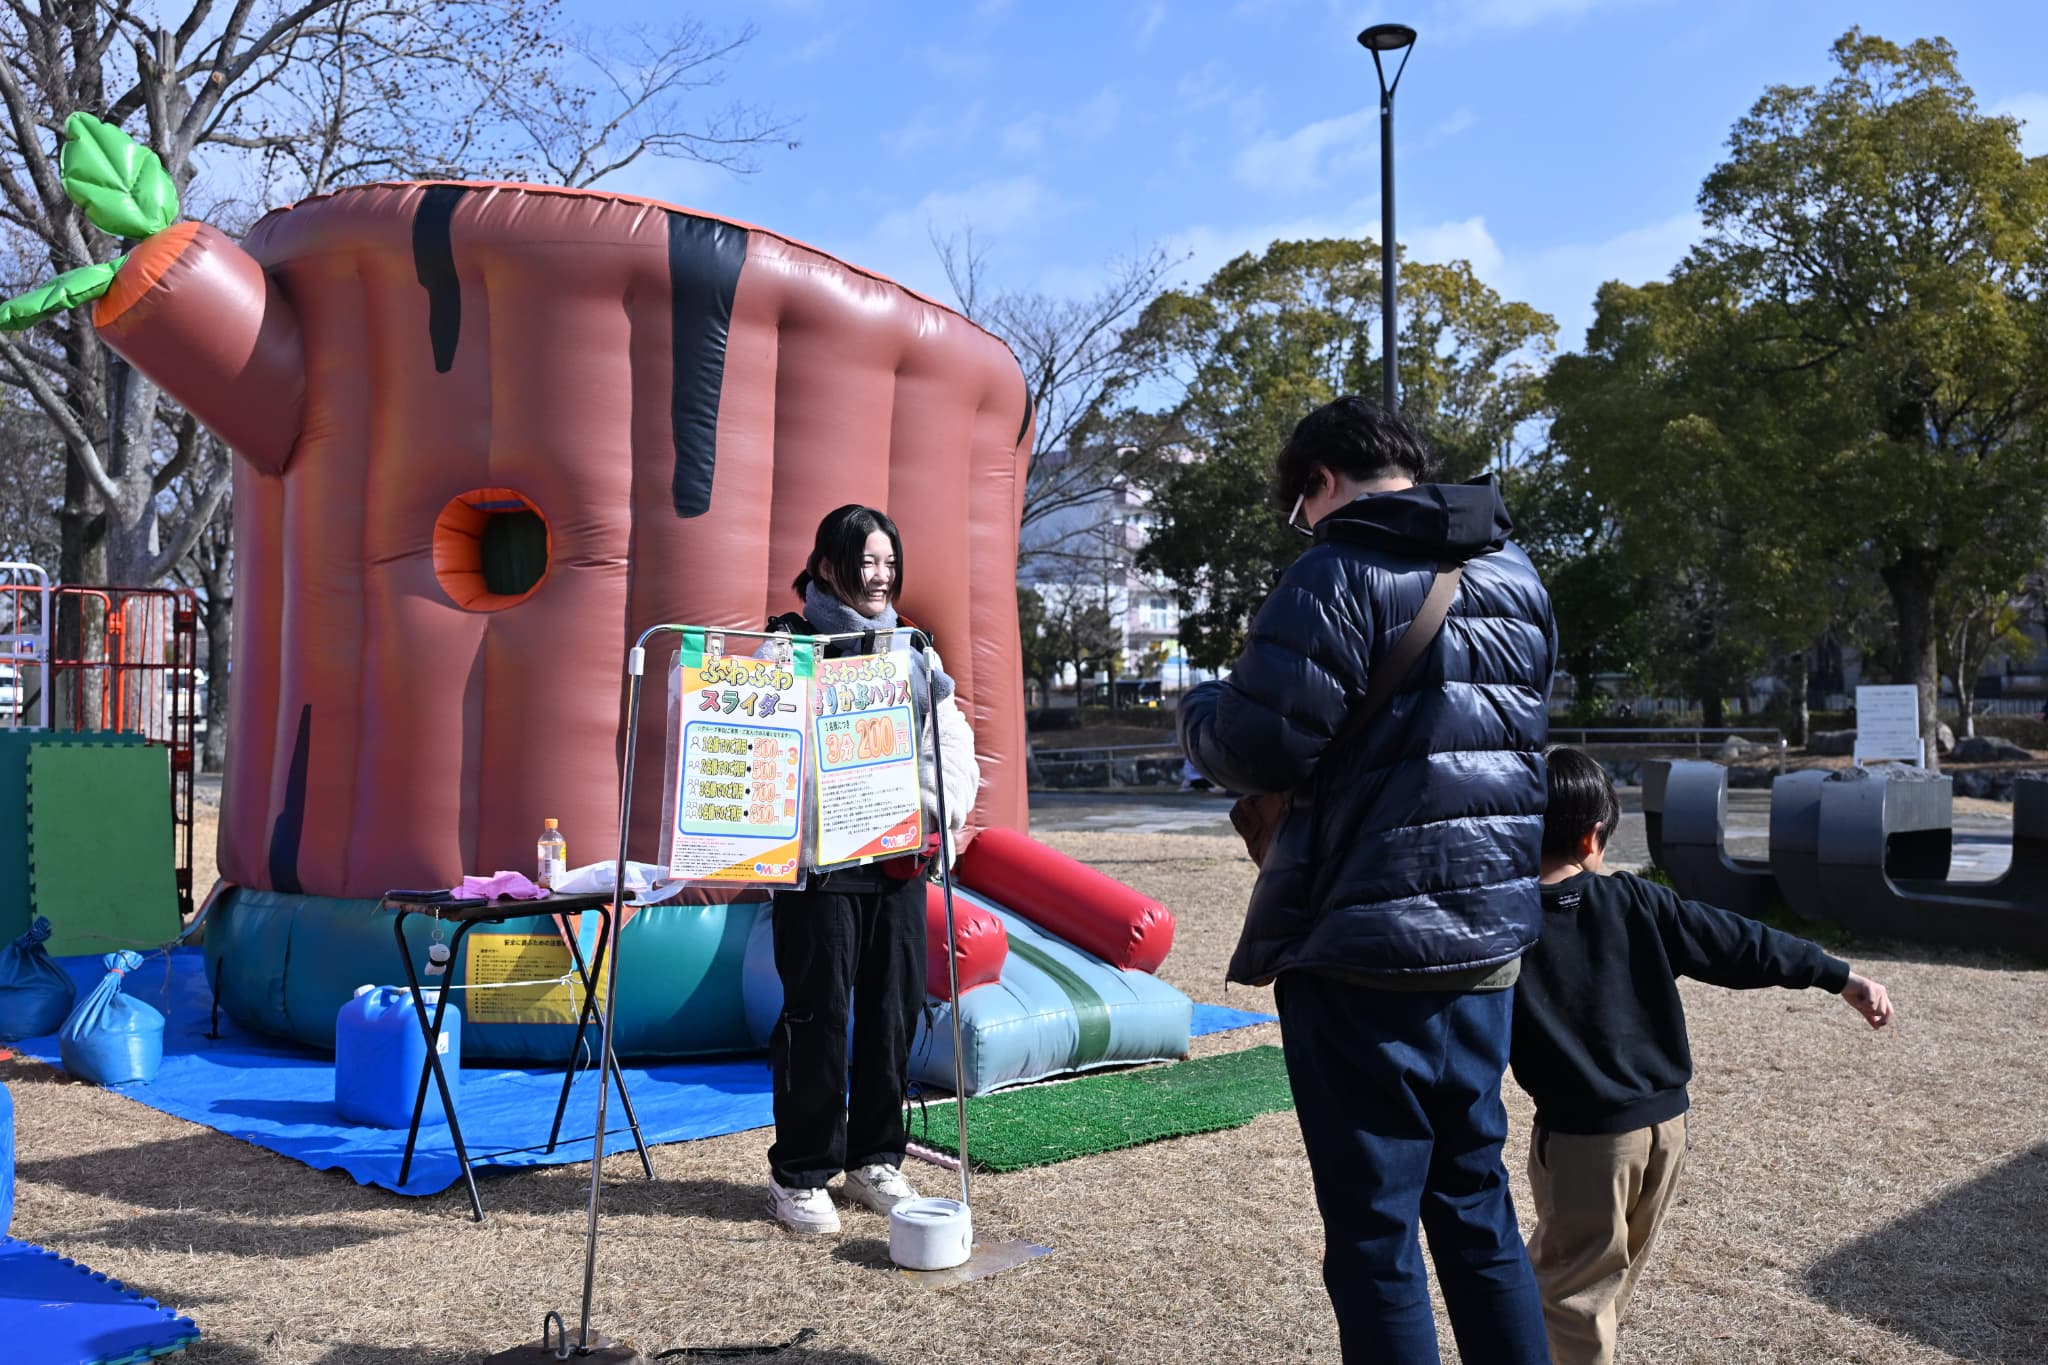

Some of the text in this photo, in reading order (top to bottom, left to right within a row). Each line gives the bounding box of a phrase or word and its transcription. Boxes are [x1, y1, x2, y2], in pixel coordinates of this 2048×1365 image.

[700, 658, 793, 691] ふわふわ
[821, 658, 896, 685] ふわふわ
[699, 690, 797, 718] スライダー
[826, 733, 855, 764] 3分
